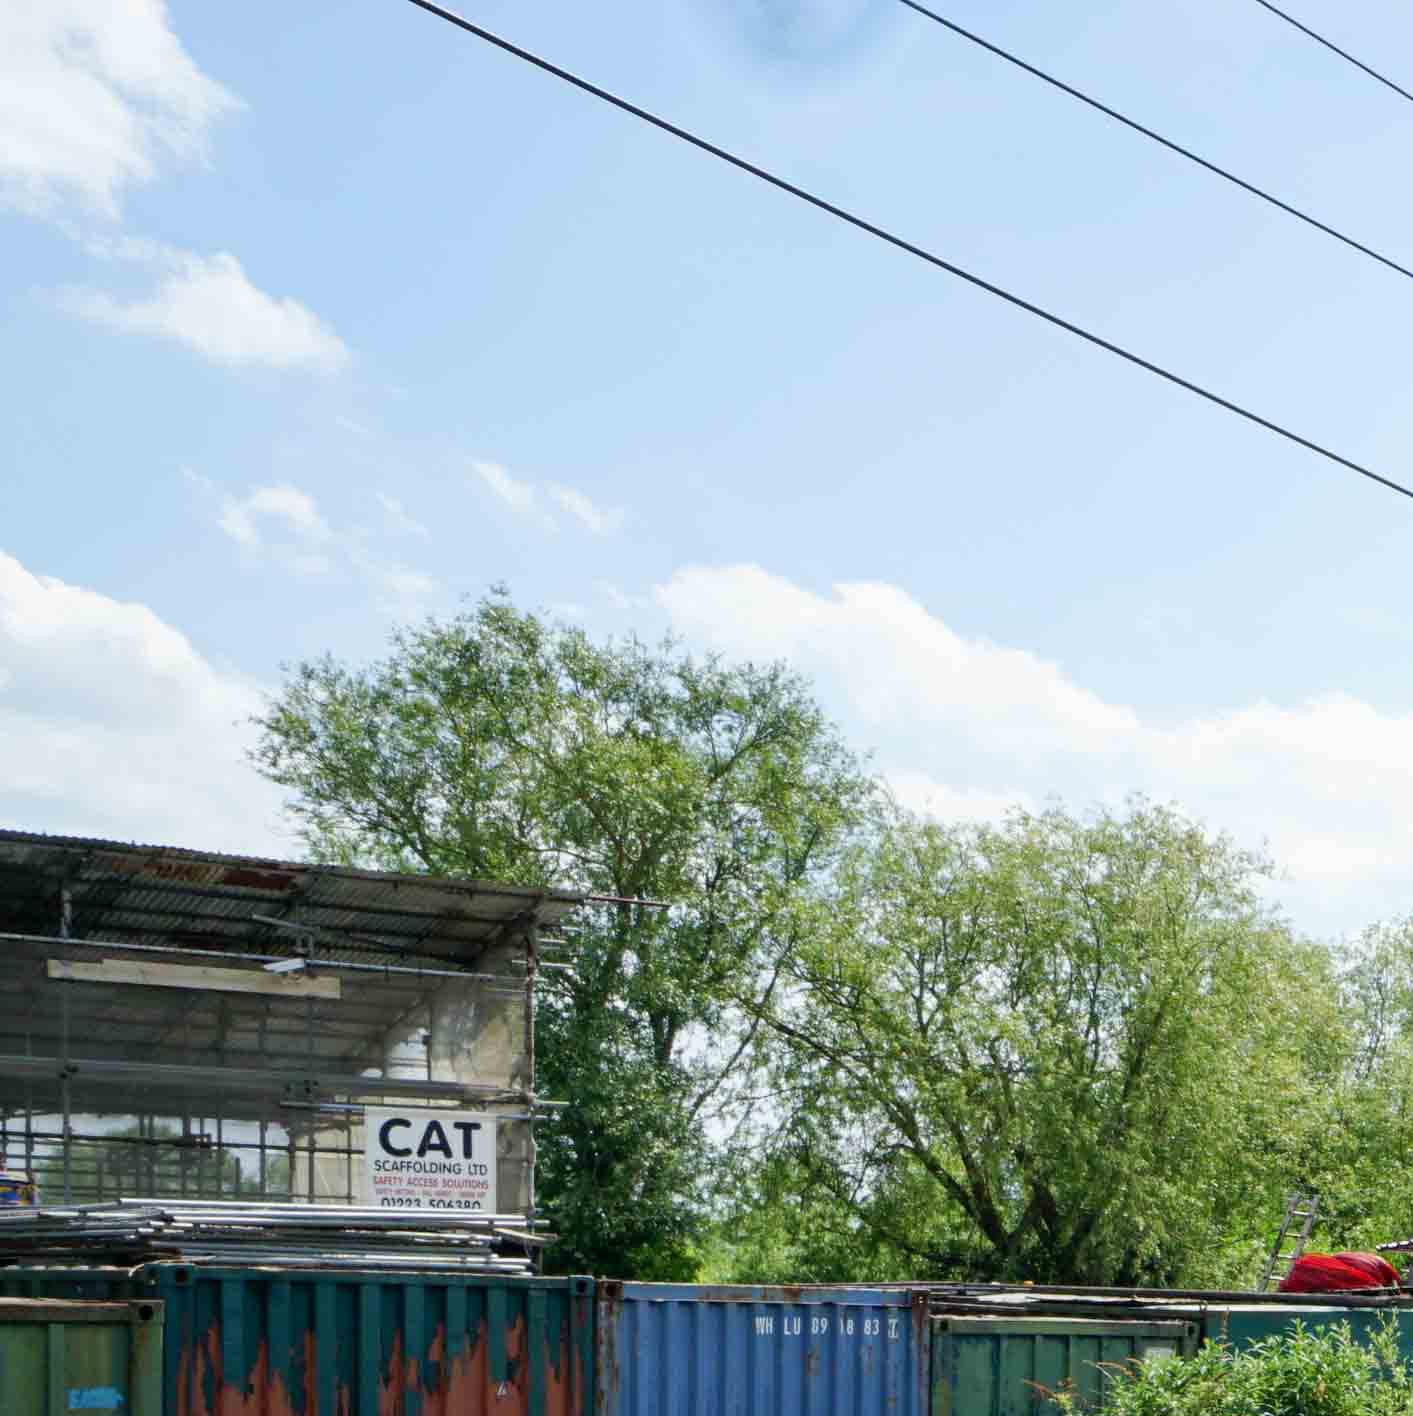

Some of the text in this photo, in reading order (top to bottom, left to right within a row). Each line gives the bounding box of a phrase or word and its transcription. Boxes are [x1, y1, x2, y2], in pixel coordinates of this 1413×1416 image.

[378, 1118, 482, 1159] CAT
[374, 1160, 488, 1176] SCAFFOLDING LTD
[374, 1175, 489, 1190] SAFETY ACCESS SOLUTIONS
[755, 1316, 774, 1336] WH
[783, 1318, 801, 1336] LU
